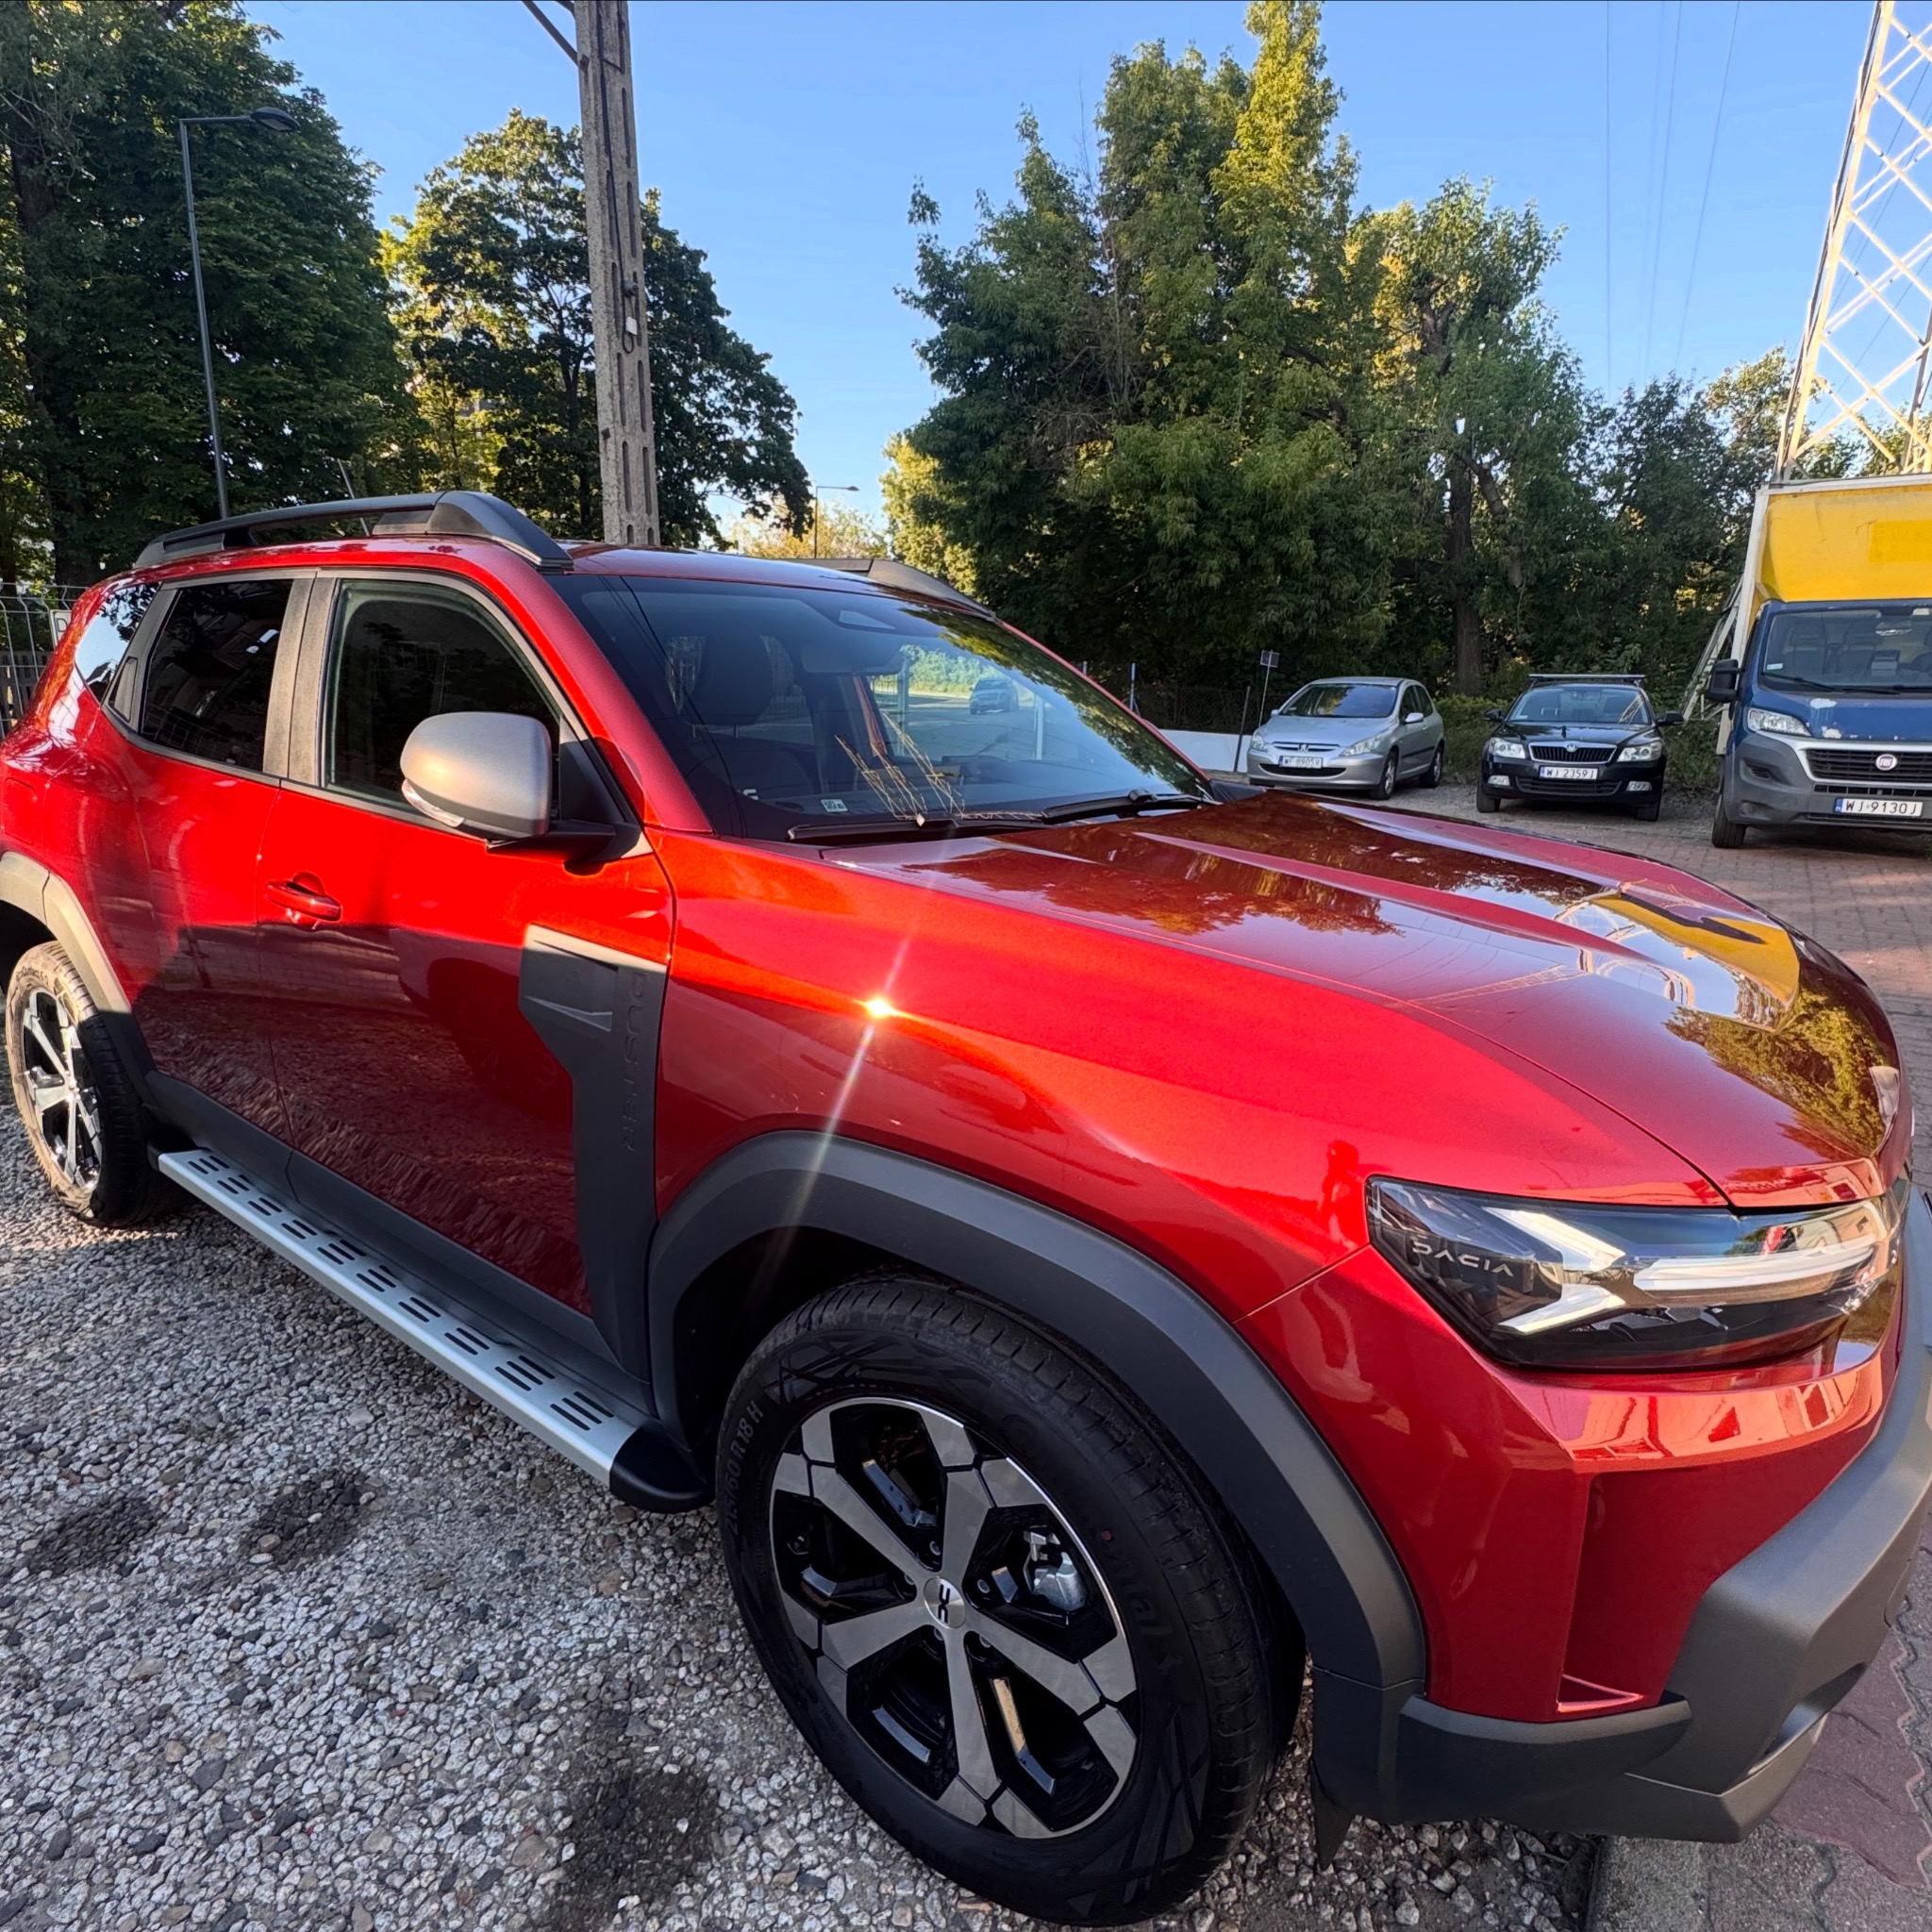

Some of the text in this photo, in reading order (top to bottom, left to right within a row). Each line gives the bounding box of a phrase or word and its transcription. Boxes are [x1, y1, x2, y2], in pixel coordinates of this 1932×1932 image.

[1845, 800, 1917, 815] WJ 9130J
[1412, 1241, 1514, 1277] DACIA
[746, 1400, 764, 1424] H
[737, 1417, 754, 1444] 18
[730, 1440, 746, 1460] R
